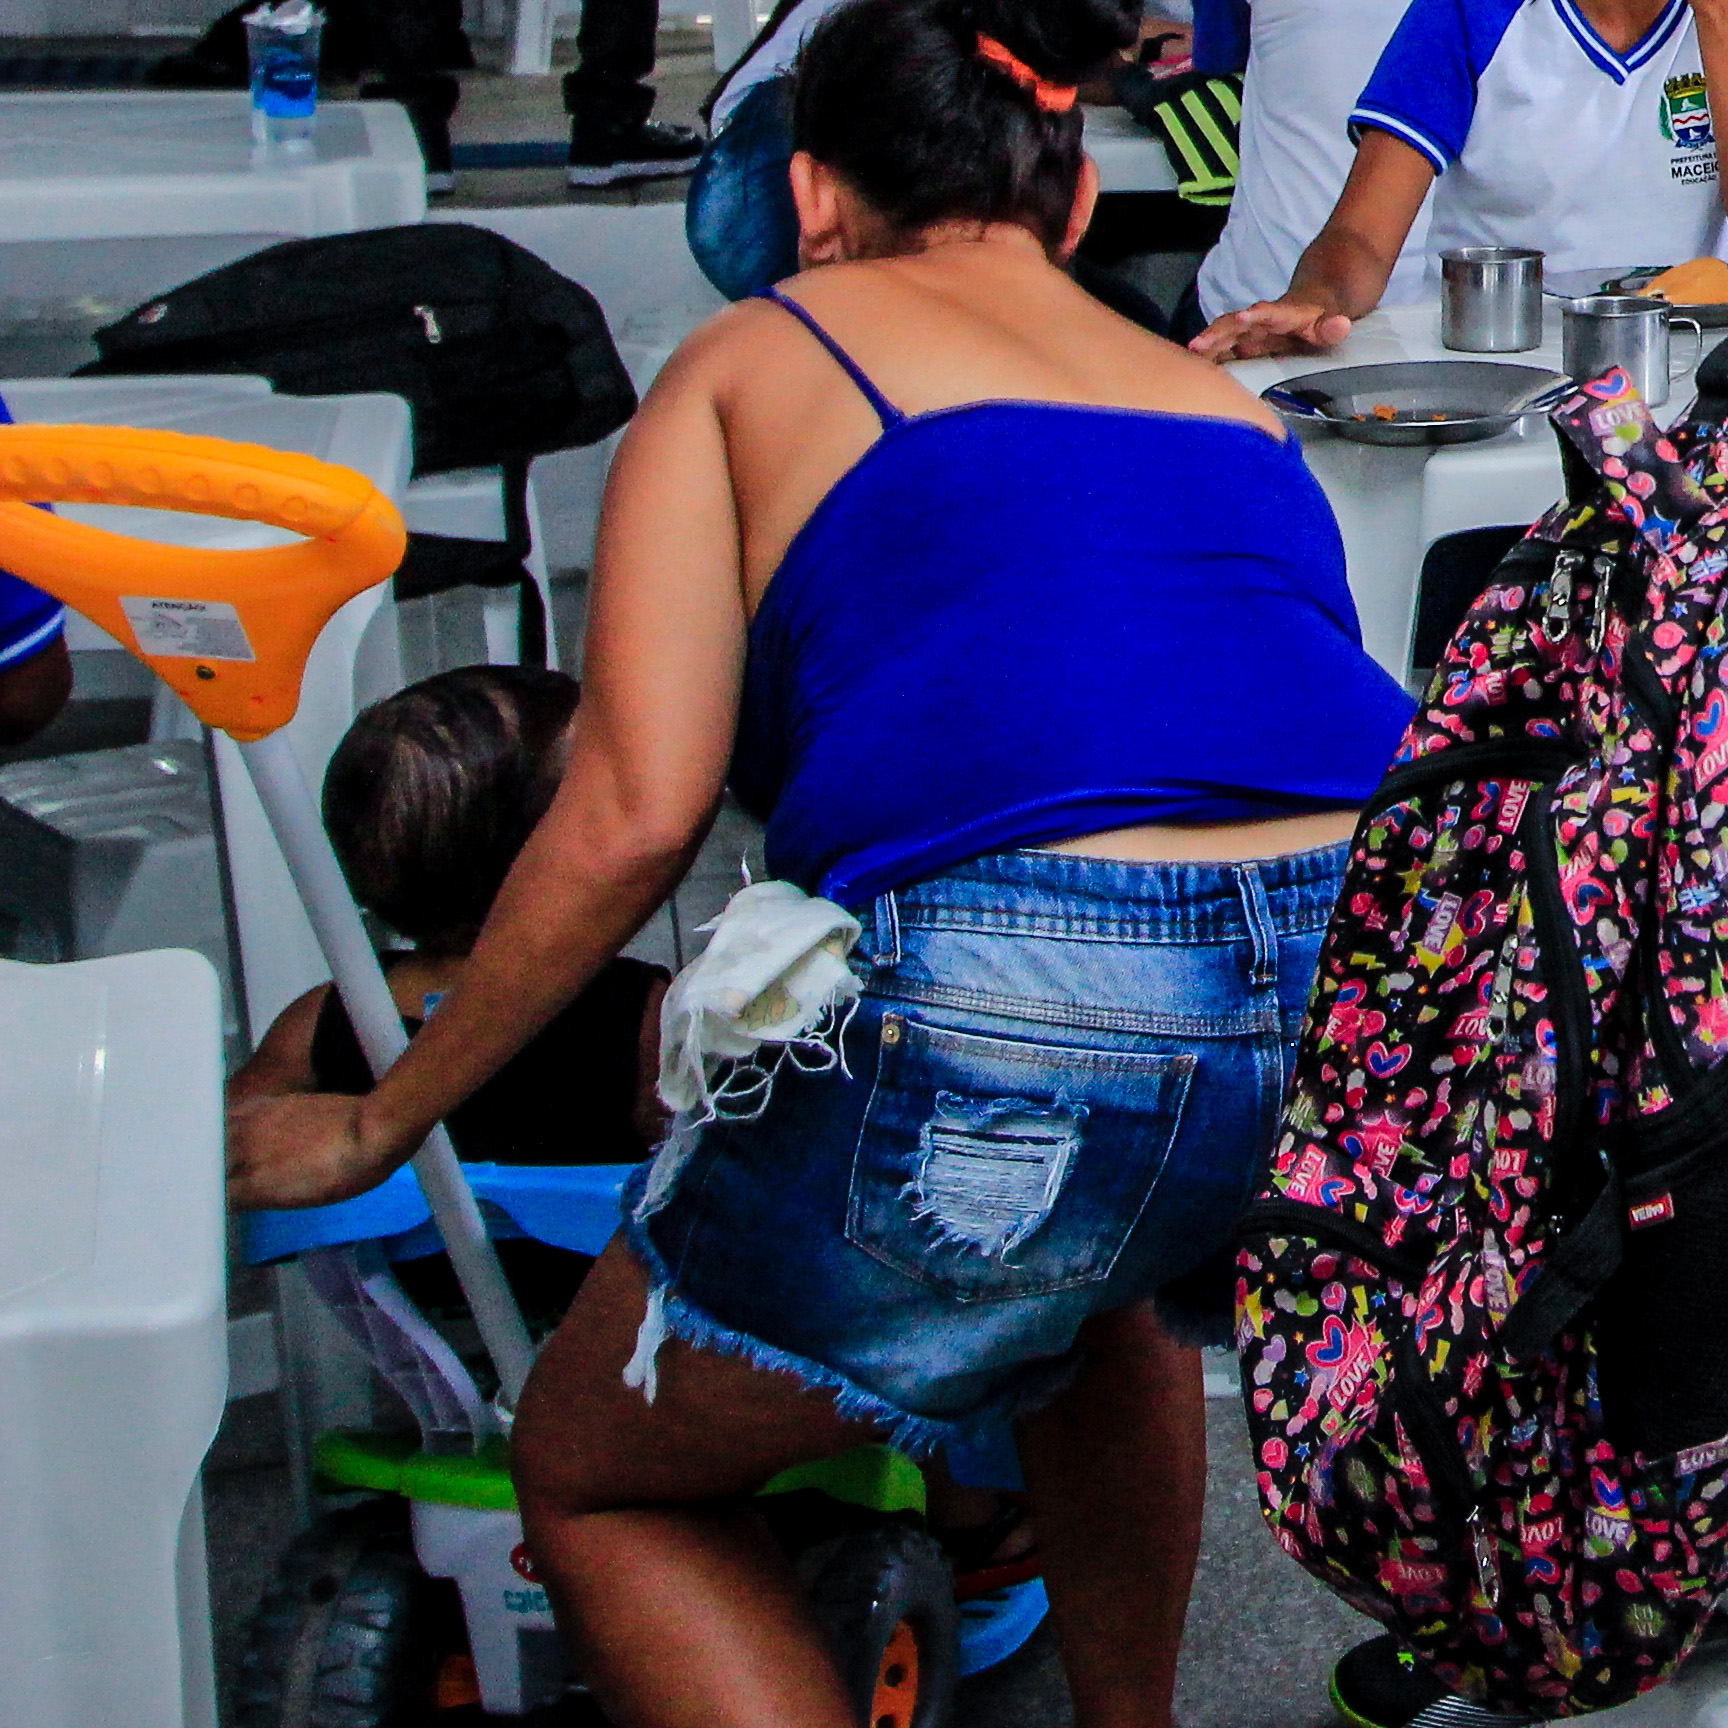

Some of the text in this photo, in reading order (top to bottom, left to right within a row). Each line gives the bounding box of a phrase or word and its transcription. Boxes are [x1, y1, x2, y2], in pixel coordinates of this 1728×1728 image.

[1498, 779, 1528, 829] LOVE
[1454, 1015, 1490, 1036] LOV
[1290, 1150, 1323, 1197] LOVE
[1334, 1352, 1374, 1408] LOVE
